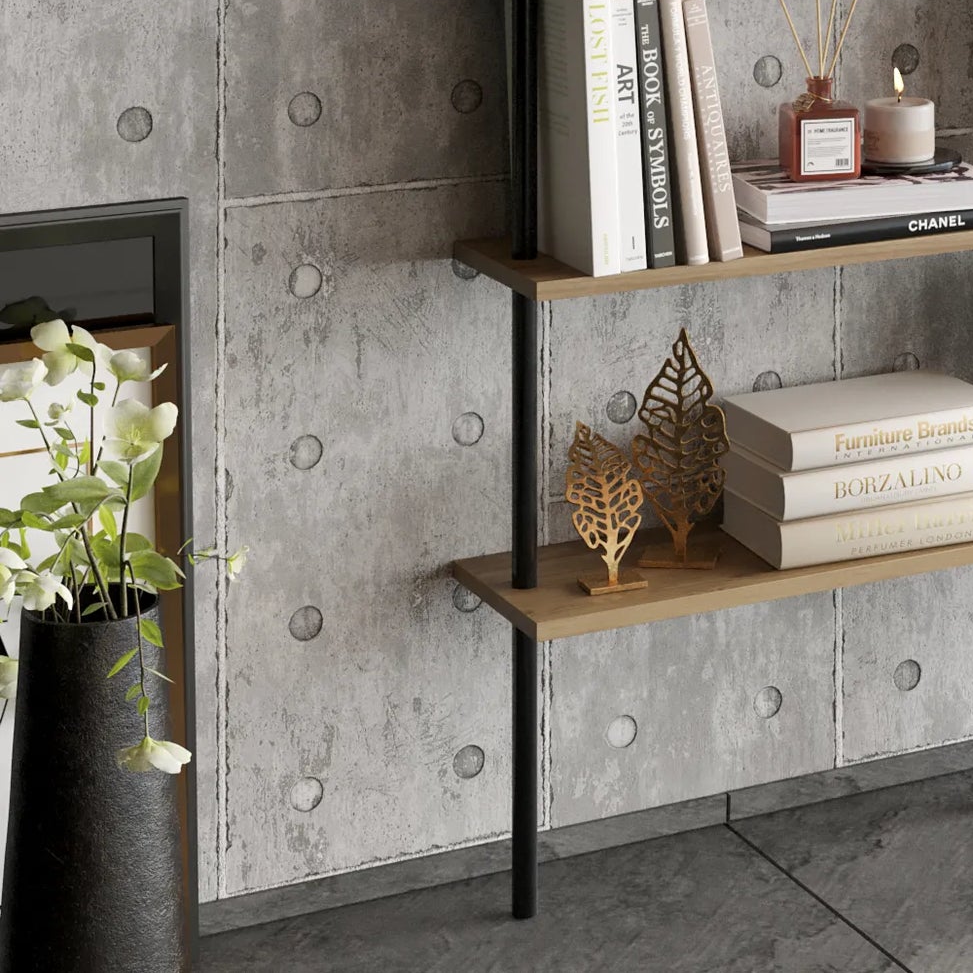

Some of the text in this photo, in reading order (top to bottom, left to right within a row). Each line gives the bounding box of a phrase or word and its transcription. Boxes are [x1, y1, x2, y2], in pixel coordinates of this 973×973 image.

[641, 23, 650, 45] THE
[589, 3, 609, 124] LOST FISH
[641, 47, 661, 105] BOOK
[616, 64, 635, 104] ART
[647, 110, 655, 125] OF
[700, 65, 730, 193] ANTIQUAIRES
[648, 128, 669, 229] SYMBOLS
[908, 214, 966, 232] CHANEL
[835, 427, 913, 453] Furniture
[834, 462, 962, 500] BORZALINO
[851, 530, 973, 555] PERFUMER LONDON
